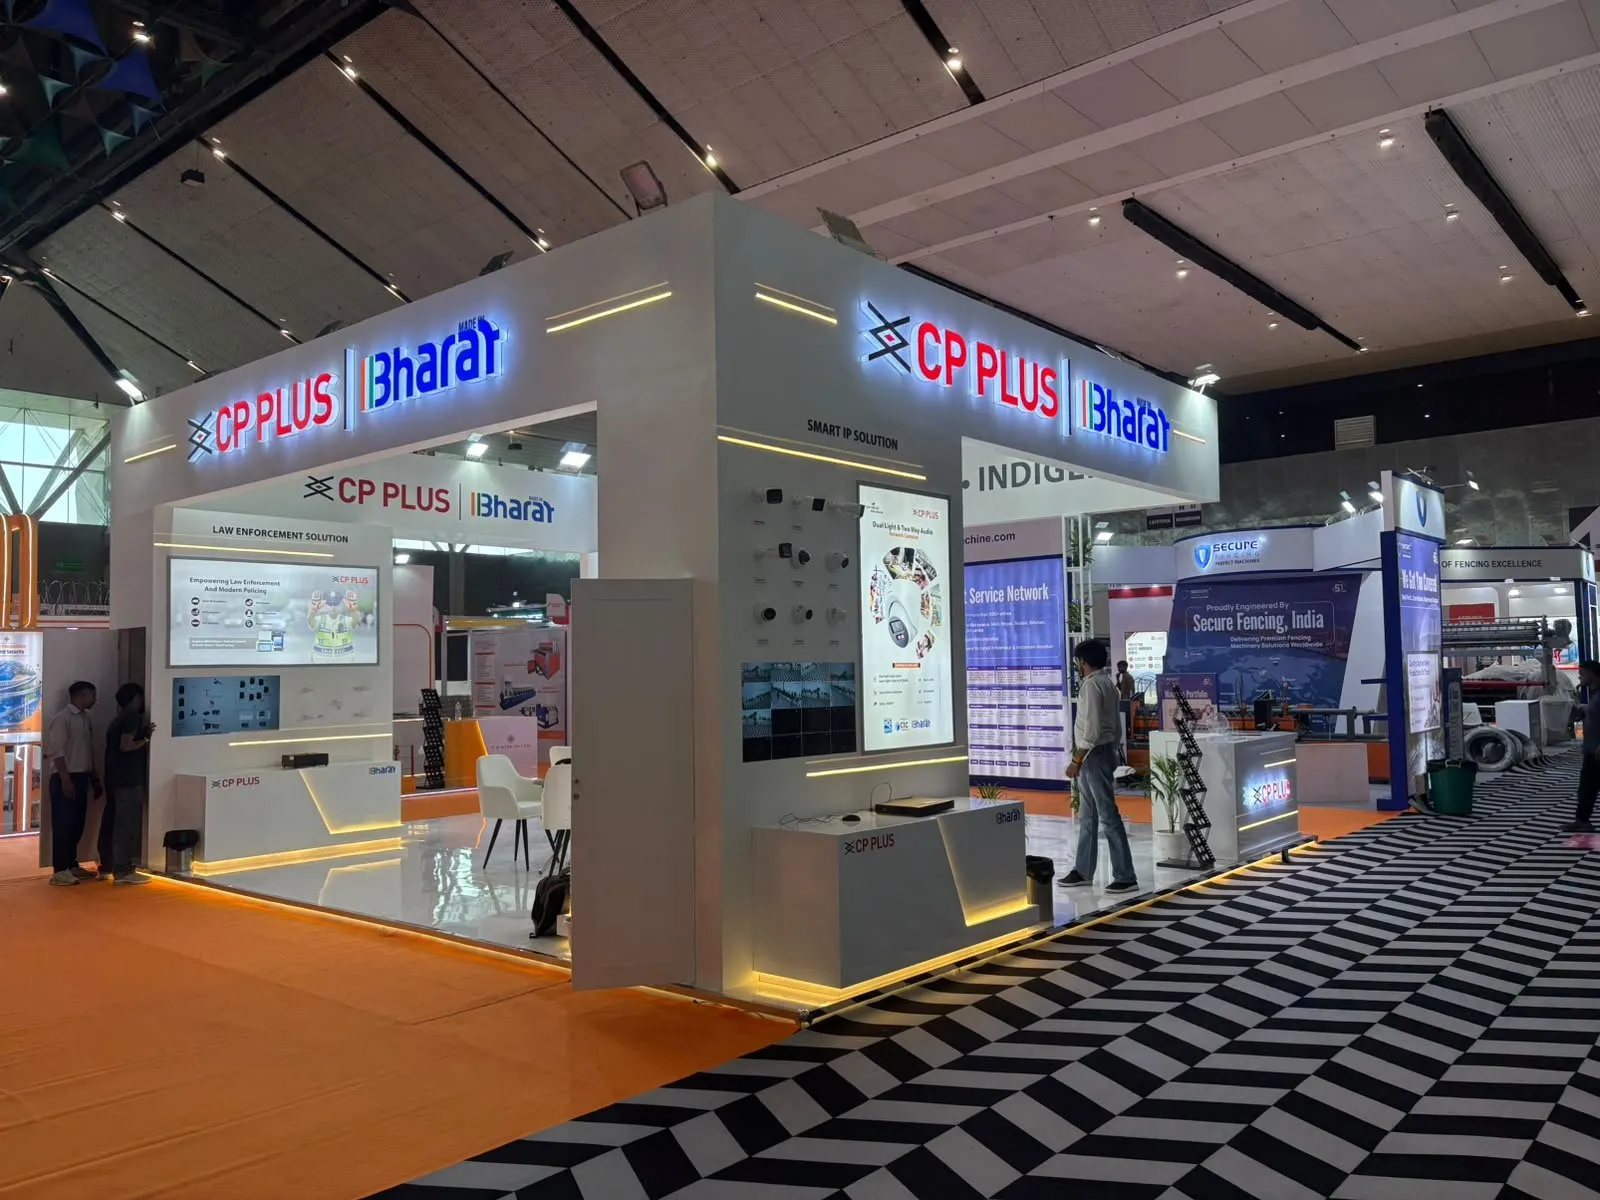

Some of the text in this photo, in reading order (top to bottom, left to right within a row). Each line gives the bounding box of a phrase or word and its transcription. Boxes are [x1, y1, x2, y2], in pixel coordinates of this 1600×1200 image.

[360, 319, 500, 412] Bharat
[917, 322, 1058, 419] CP PLUS
[216, 373, 332, 452] CP PLUS
[1082, 379, 1170, 452] Bharat
[807, 419, 898, 450] SMART IP SOLUTION
[979, 462, 1093, 491] INDIG
[338, 477, 450, 513] CP PLUS
[471, 492, 554, 523] Bharat
[926, 511, 938, 519] PLUS
[212, 525, 348, 543] LAW ENFORCEMENT SOLUTION
[885, 522, 896, 531] Light
[189, 577, 228, 586] Empowering
[970, 586, 1004, 604] Service
[1007, 583, 1049, 601] Network
[1235, 602, 1278, 611] Engineered
[1193, 610, 1324, 634] Secure Fencing, India
[1186, 690, 1208, 698] Portfolio
[369, 766, 395, 775] Bharat
[222, 776, 259, 788] CP PLUS
[1262, 784, 1271, 806] CP
[996, 808, 1021, 824] Bharat
[856, 833, 894, 853] CP PLUS
